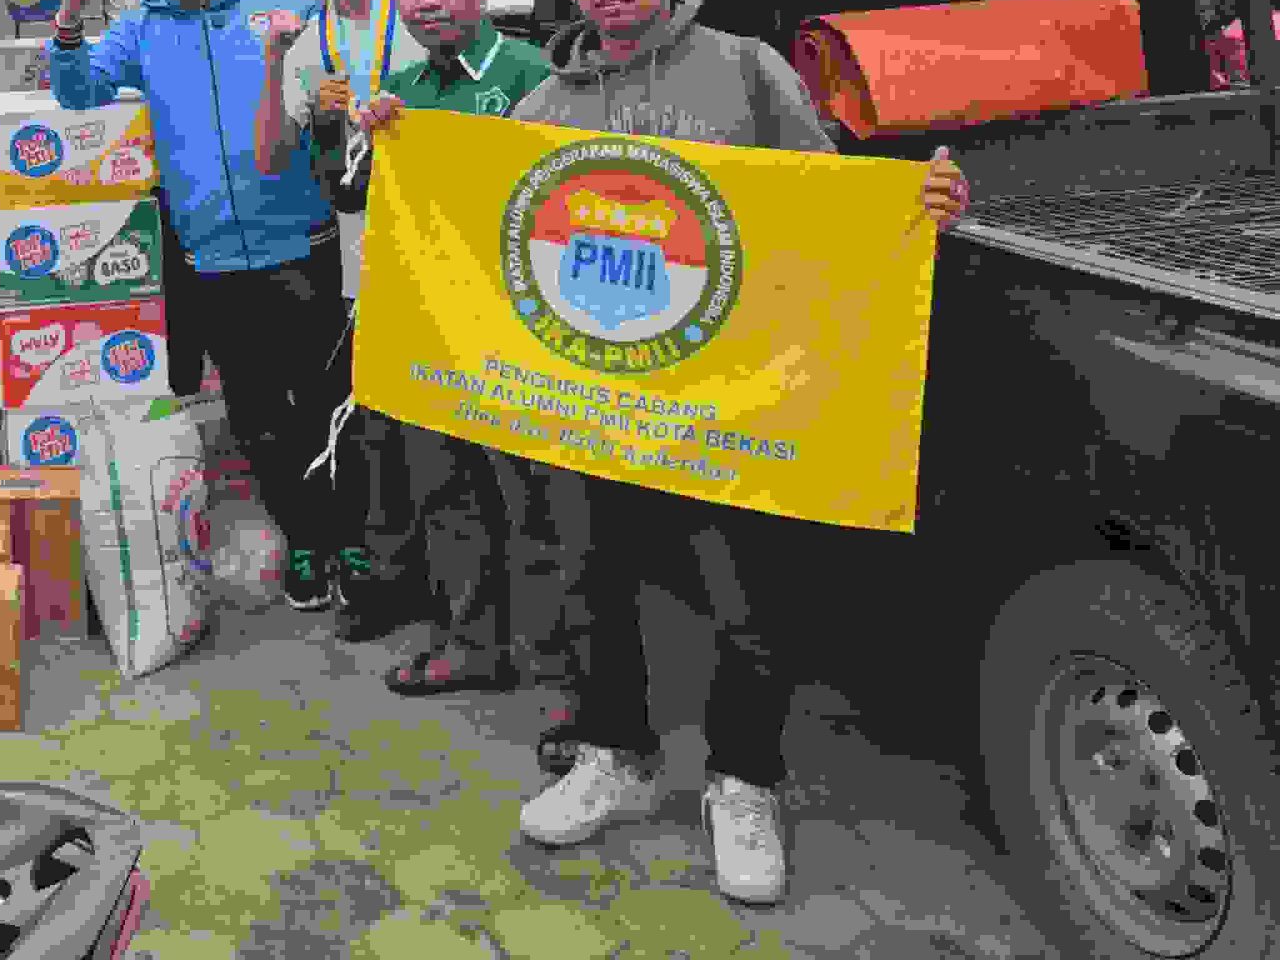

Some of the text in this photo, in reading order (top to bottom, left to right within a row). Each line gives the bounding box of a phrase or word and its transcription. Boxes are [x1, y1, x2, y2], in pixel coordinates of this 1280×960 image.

[571, 239, 656, 295] PMII
[618, 391, 716, 422] CABANG
[637, 414, 697, 442] KOTA
[705, 430, 796, 461] BEKASI
